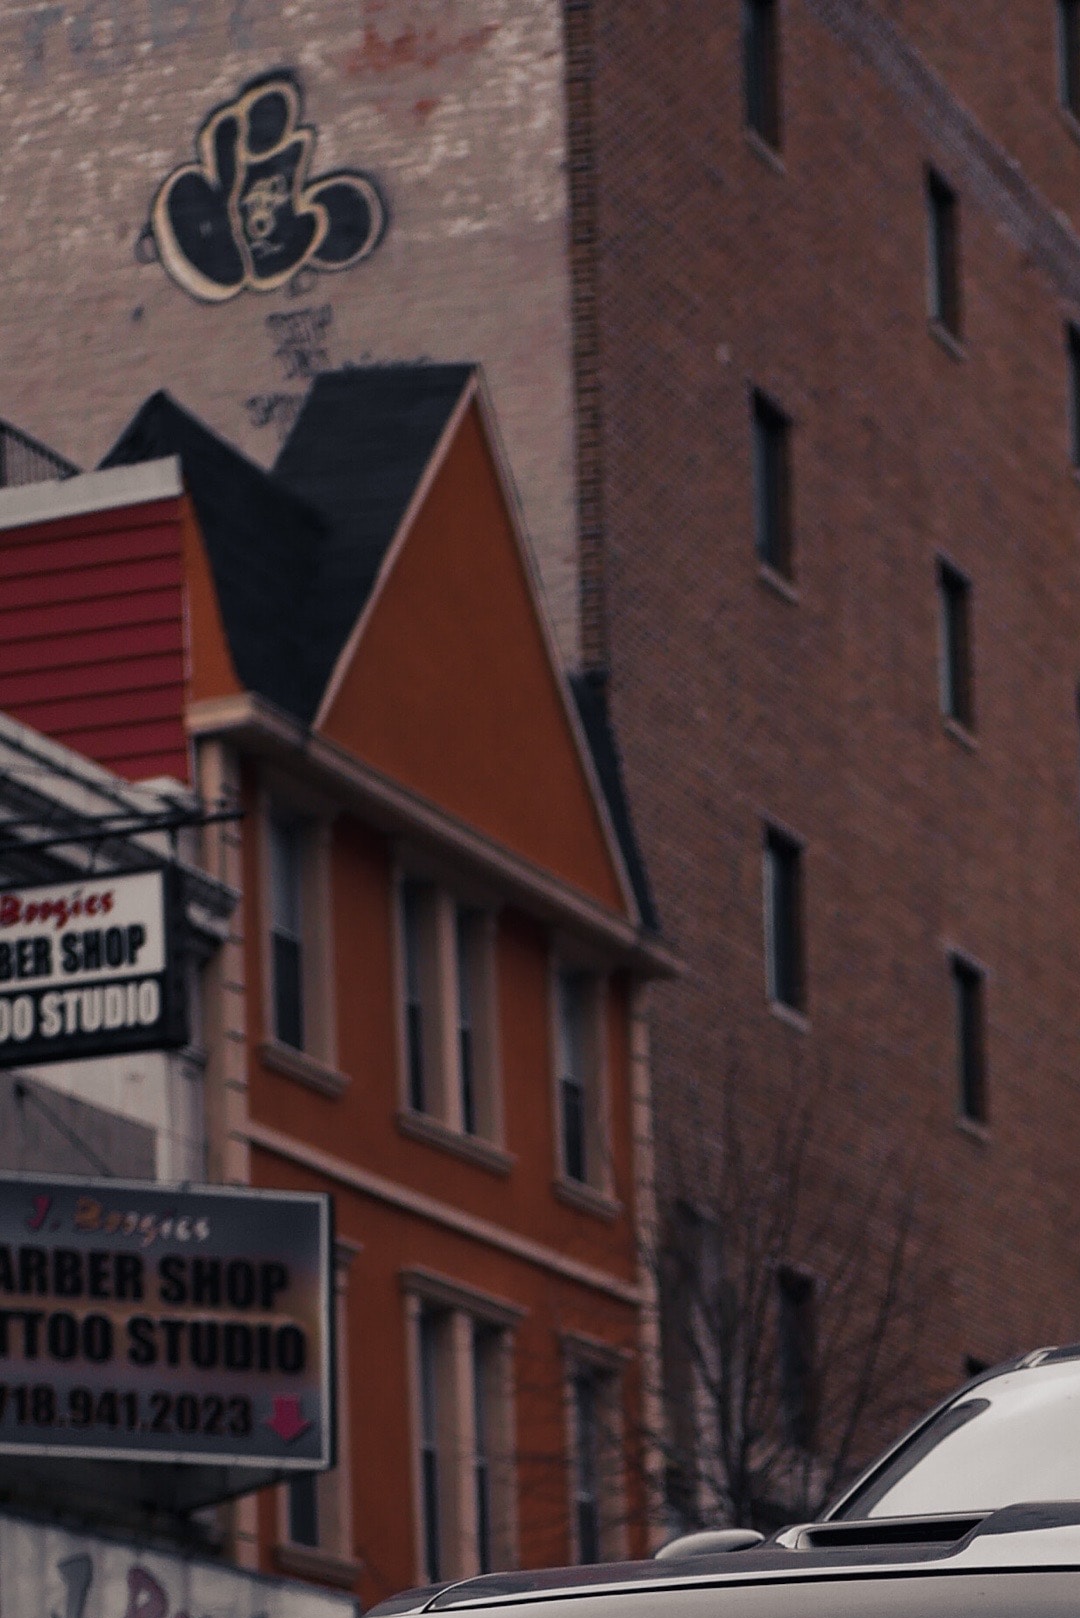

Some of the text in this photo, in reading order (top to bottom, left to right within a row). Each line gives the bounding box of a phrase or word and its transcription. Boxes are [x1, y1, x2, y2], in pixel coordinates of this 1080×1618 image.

[62, 924, 146, 974] SHOP
[40, 979, 160, 1038] STUDIO
[158, 1255, 289, 1309] SHOP
[127, 1315, 306, 1374] STUDIO
